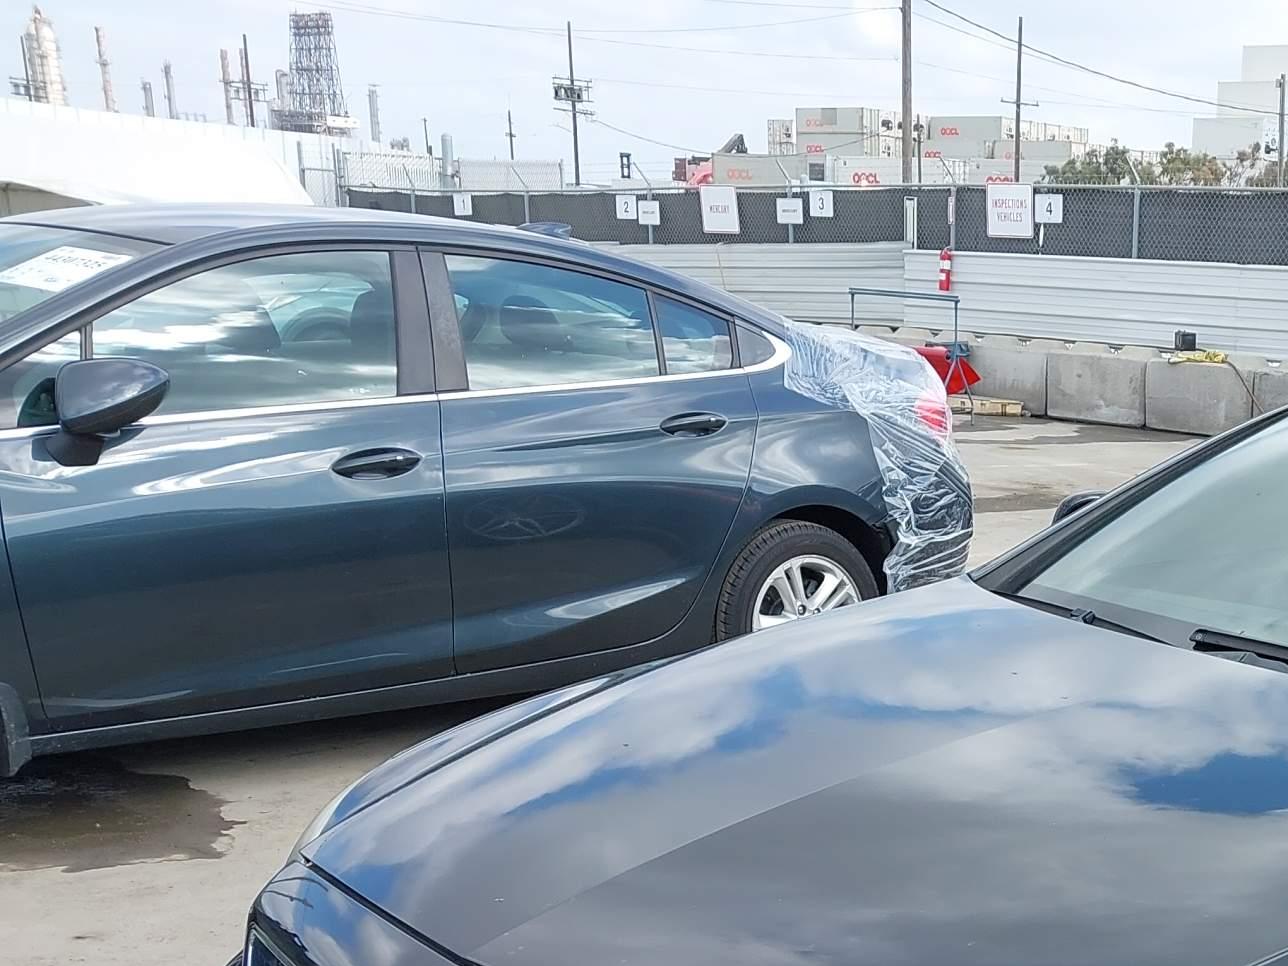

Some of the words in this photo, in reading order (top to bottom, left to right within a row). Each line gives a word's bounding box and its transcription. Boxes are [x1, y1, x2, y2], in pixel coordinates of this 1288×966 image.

[941, 128, 959, 136] OOCL
[806, 144, 824, 153] OOCL
[623, 201, 629, 213] 2
[818, 197, 825, 210] 3
[991, 198, 1027, 209] INSPECTIONS
[1045, 202, 1053, 216] 4
[996, 212, 1023, 223] VEHICLES
